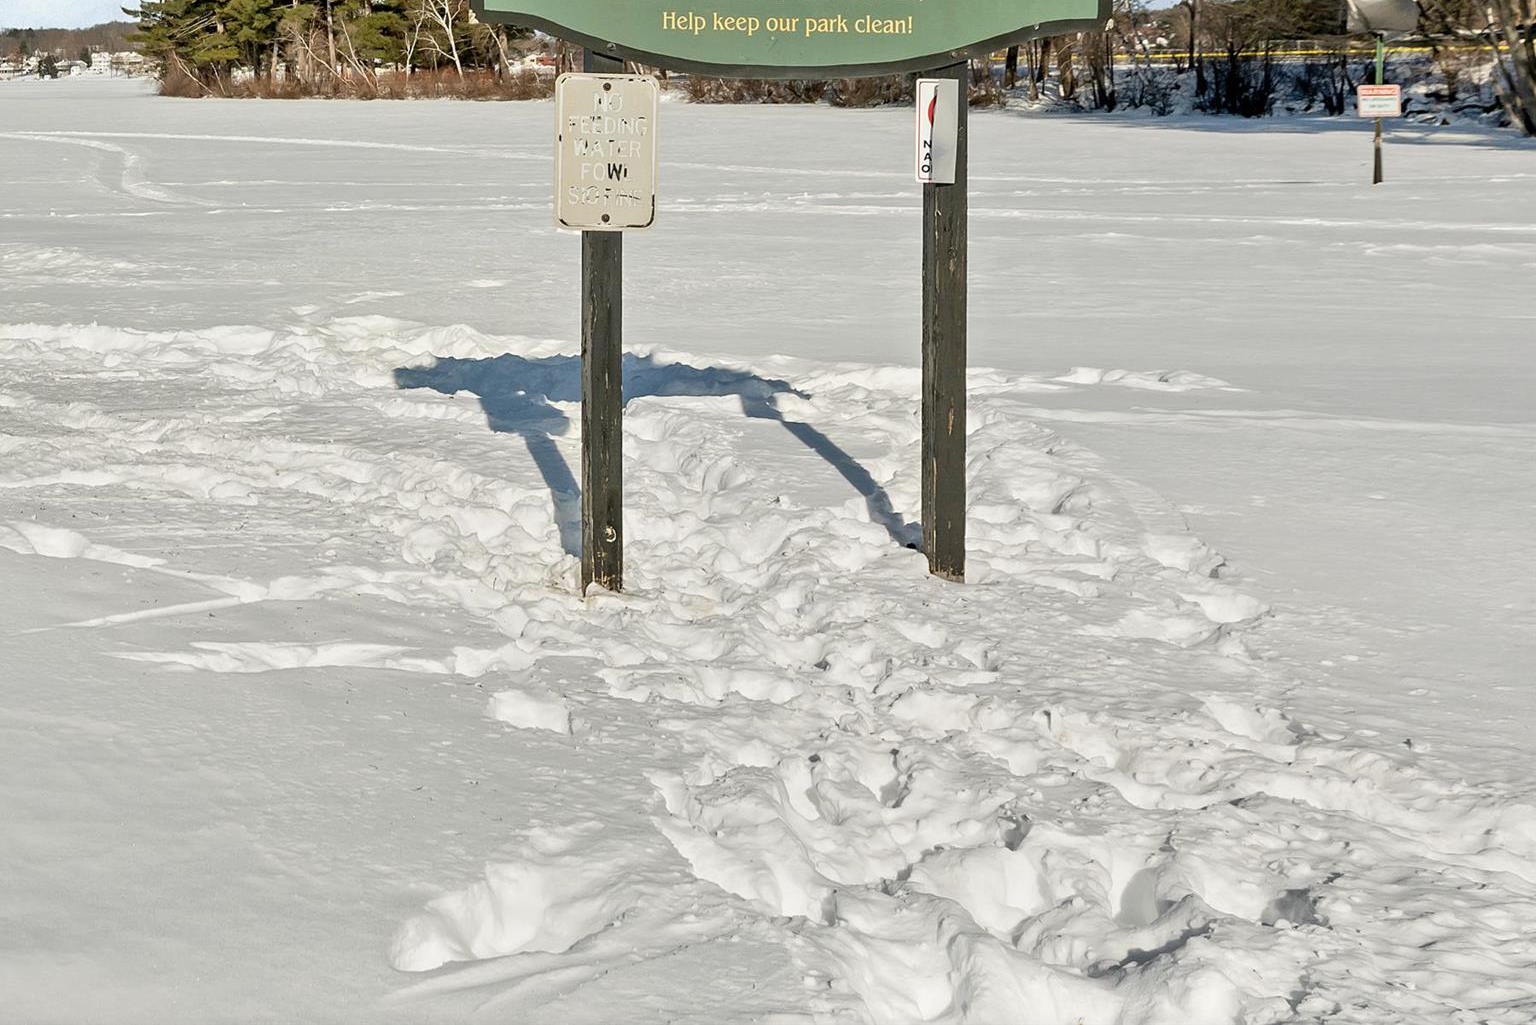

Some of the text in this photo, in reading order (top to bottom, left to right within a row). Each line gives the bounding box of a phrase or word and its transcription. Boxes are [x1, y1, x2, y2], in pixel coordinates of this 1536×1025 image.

[662, 11, 913, 37] Help keep our park clean!
[593, 92, 623, 112] NO
[569, 116, 647, 136] FEEDING
[573, 139, 641, 158] WATER
